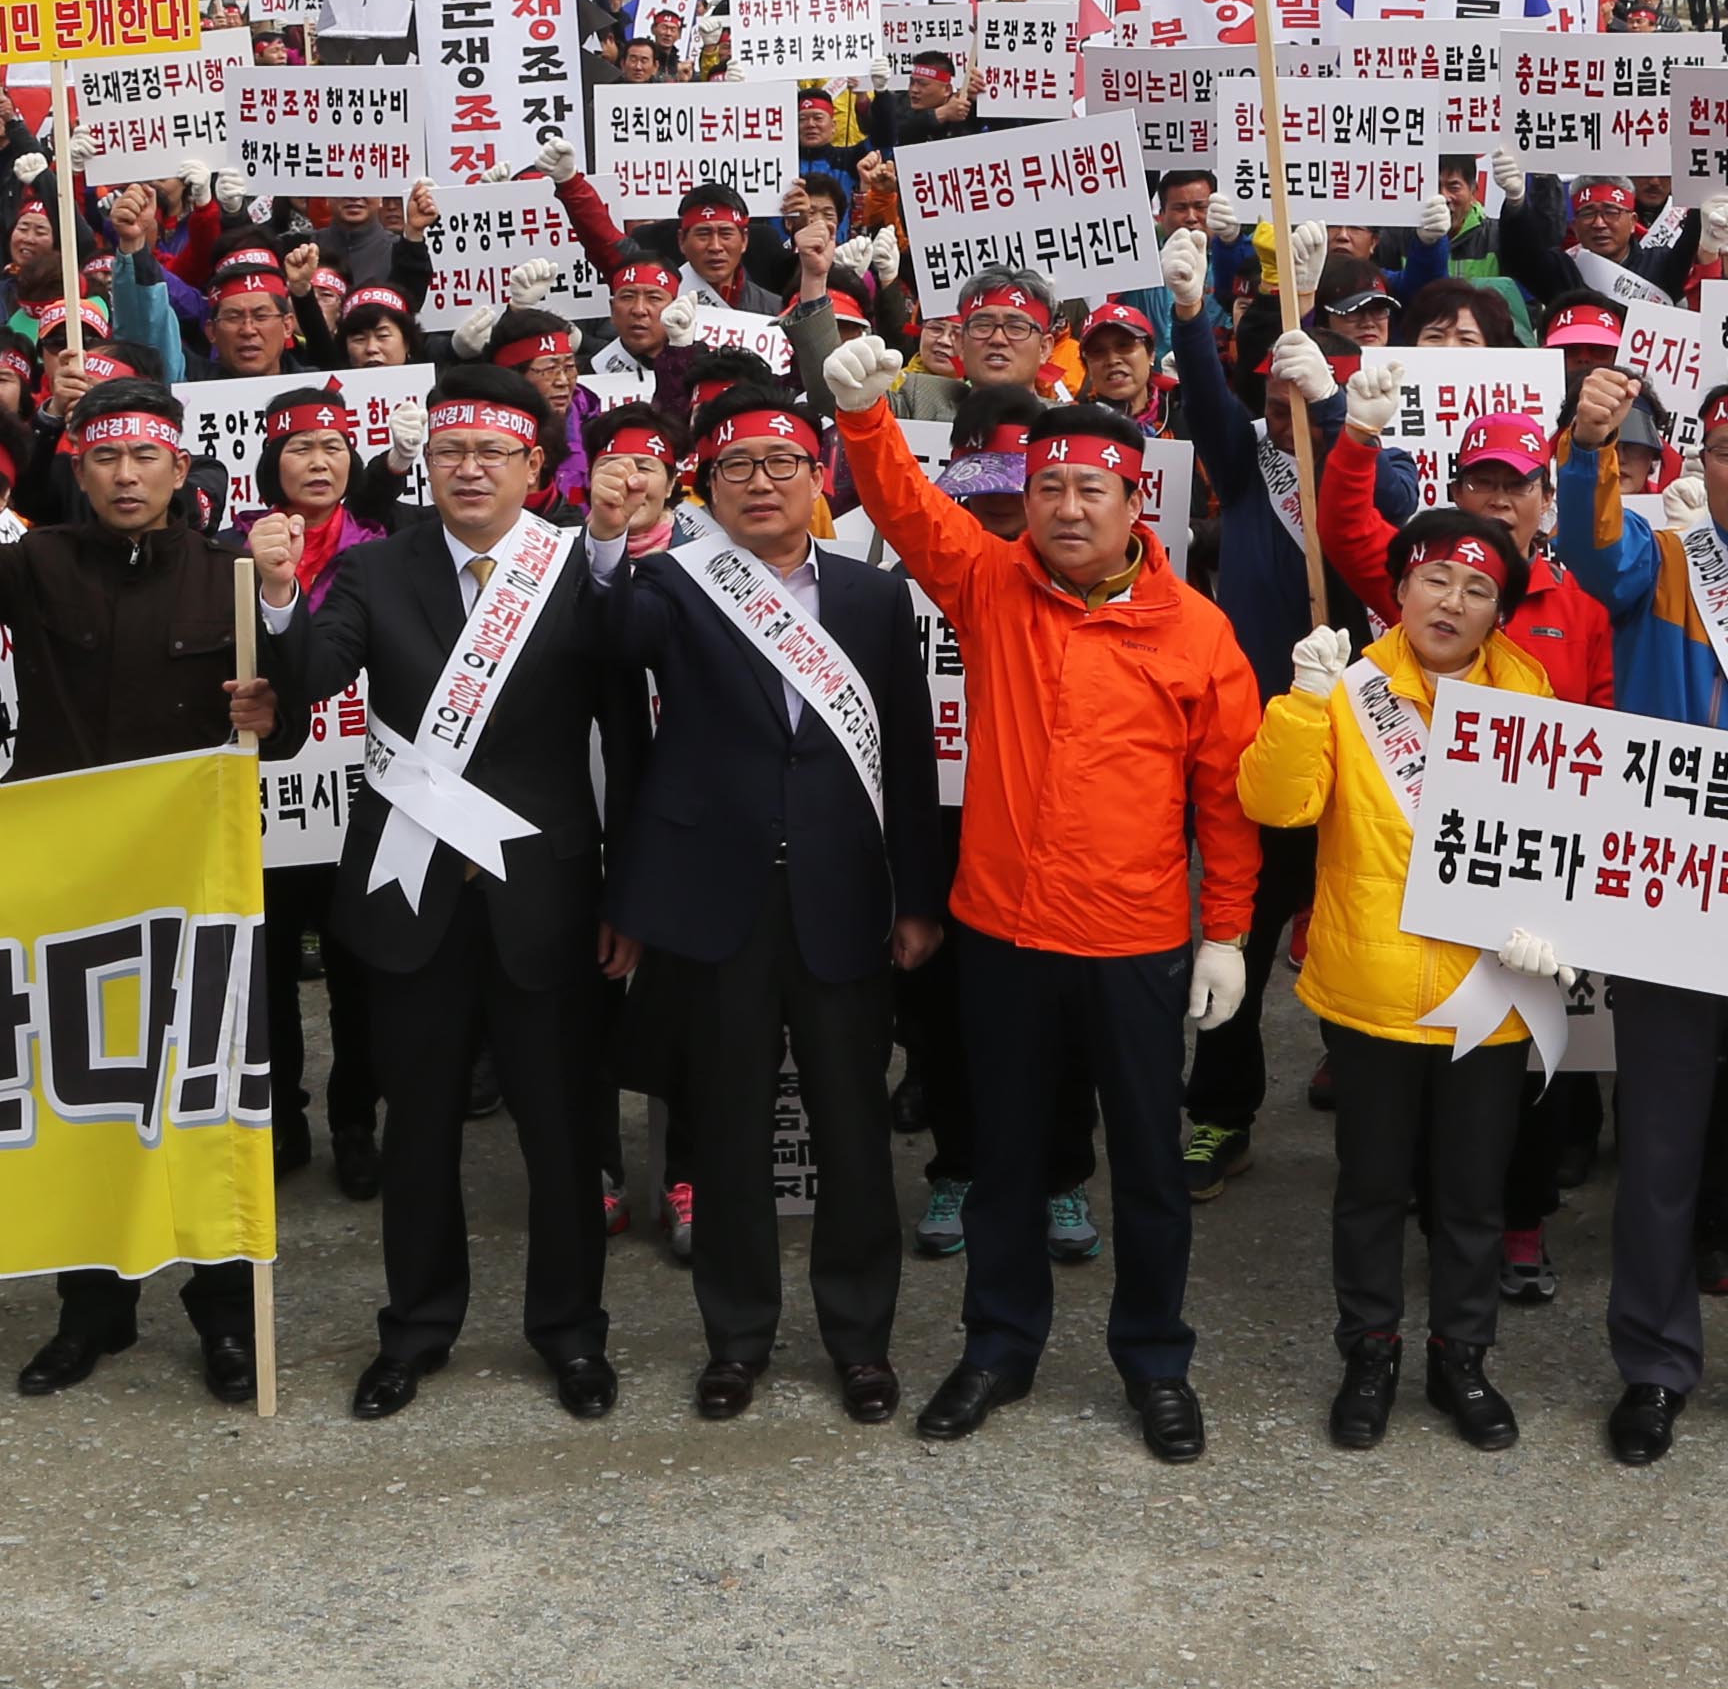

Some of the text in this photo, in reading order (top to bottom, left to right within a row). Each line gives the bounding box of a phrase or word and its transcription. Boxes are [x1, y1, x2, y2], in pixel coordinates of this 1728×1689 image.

[739, 31, 874, 65] 국무총리 찾아왔다
[985, 19, 1056, 53] 분쟁조장
[985, 66, 1057, 99] 행자부는
[1515, 53, 1606, 98] 충남도민
[239, 86, 409, 125] 분쟁조정 행정낭비
[1514, 109, 1602, 151] 충남도계
[911, 140, 1128, 220] 헌재결정 무시행위
[1035, 213, 1139, 275] 무너진다
[768, 414, 795, 437] 수
[1046, 439, 1121, 469] 사 수
[1457, 540, 1486, 565] 수
[431, 670, 490, 750] 정답이다
[1446, 710, 1604, 797] 도계사수
[1433, 807, 1585, 902] 충남도가
